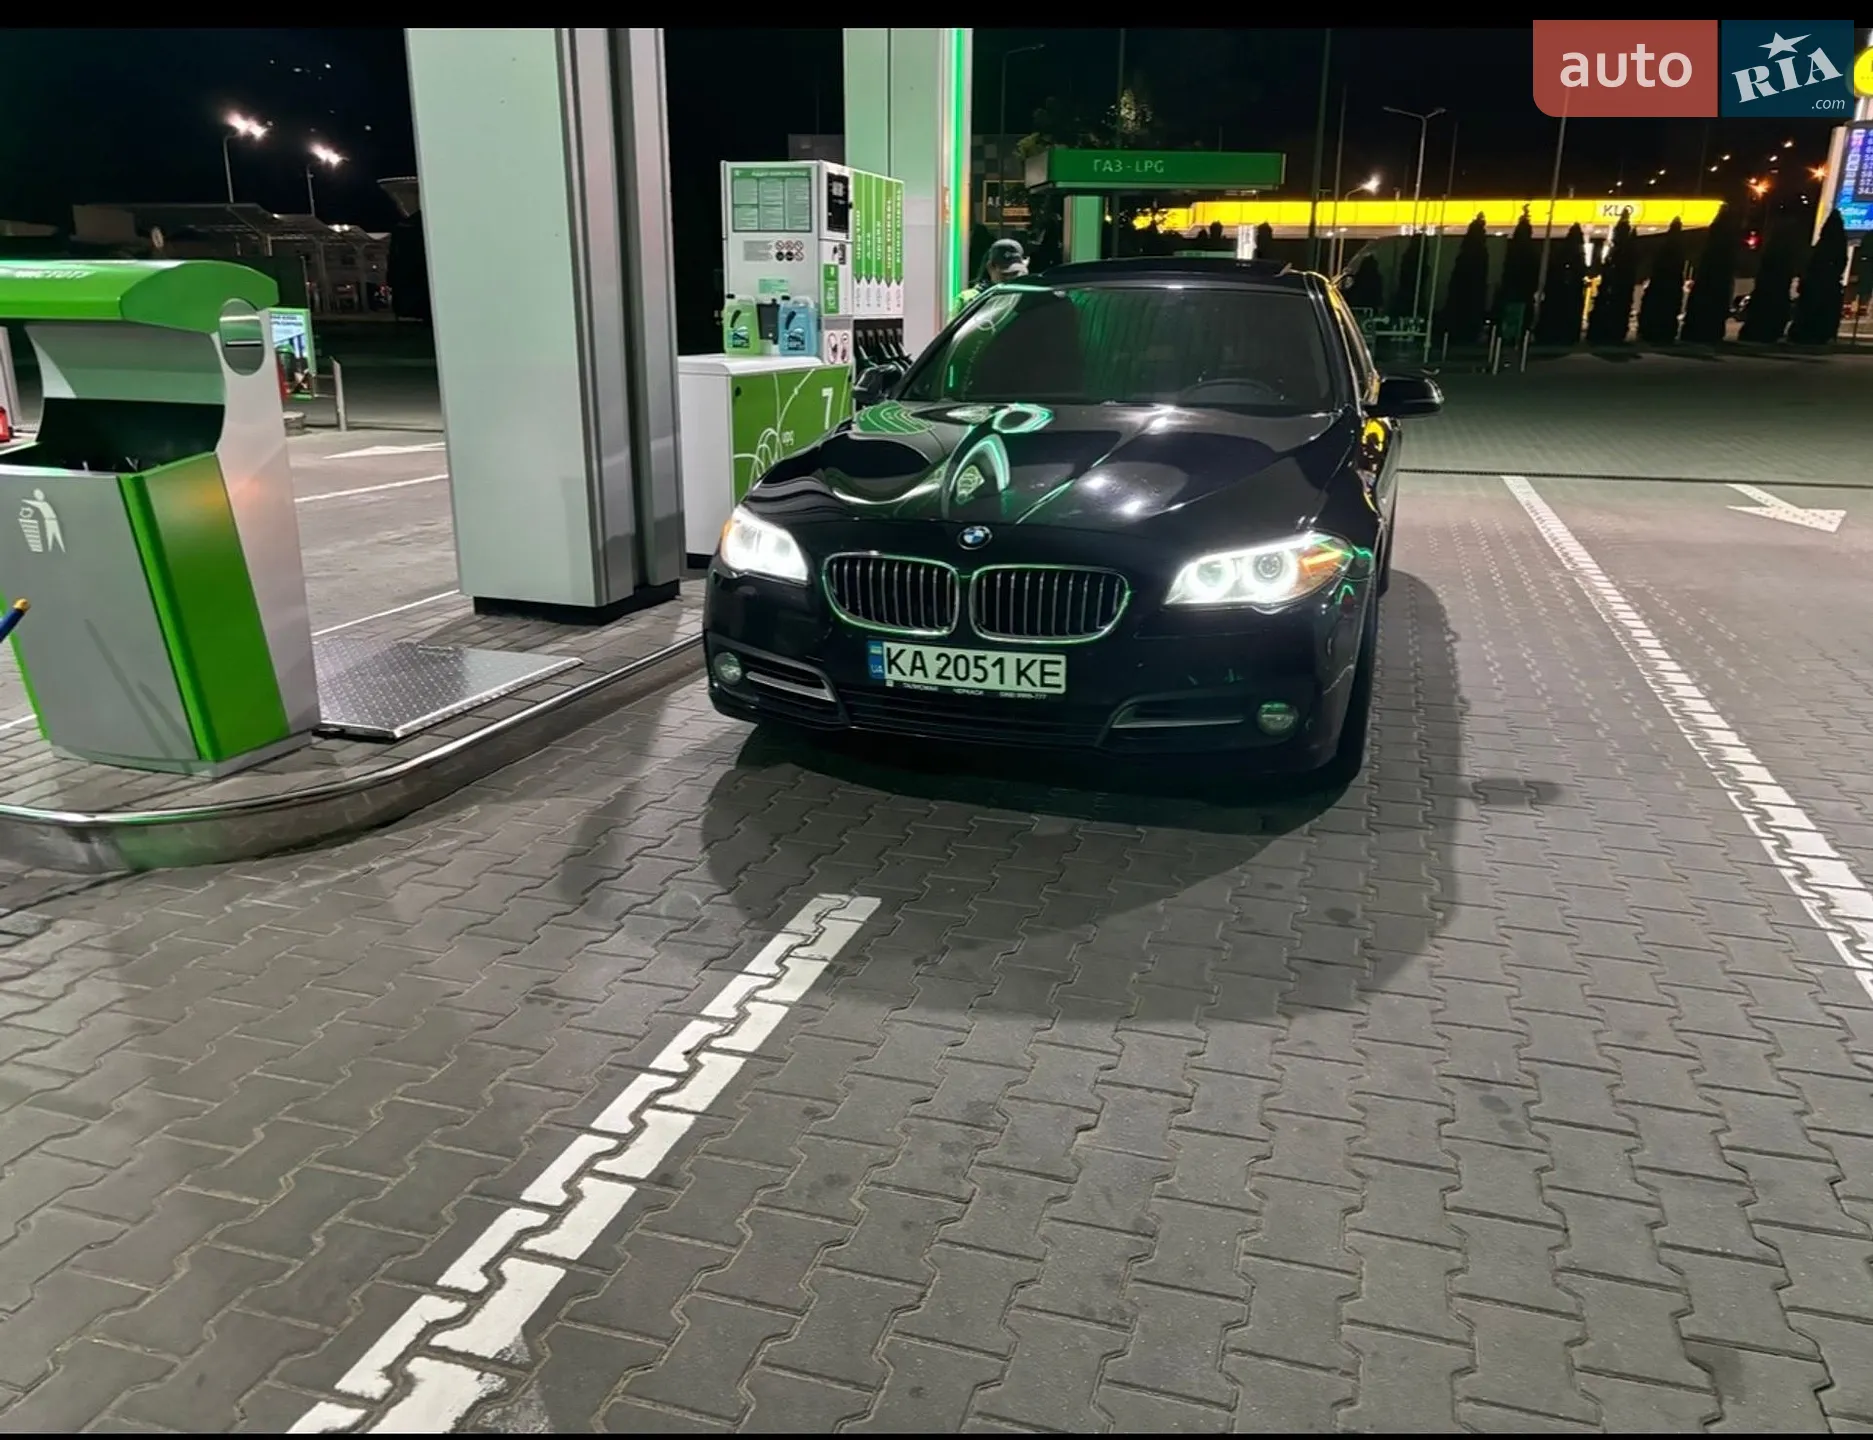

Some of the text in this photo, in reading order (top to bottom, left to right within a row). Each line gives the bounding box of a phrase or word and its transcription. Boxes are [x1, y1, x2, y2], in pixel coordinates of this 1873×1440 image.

[886, 647, 1062, 688] KA 2051 KE
